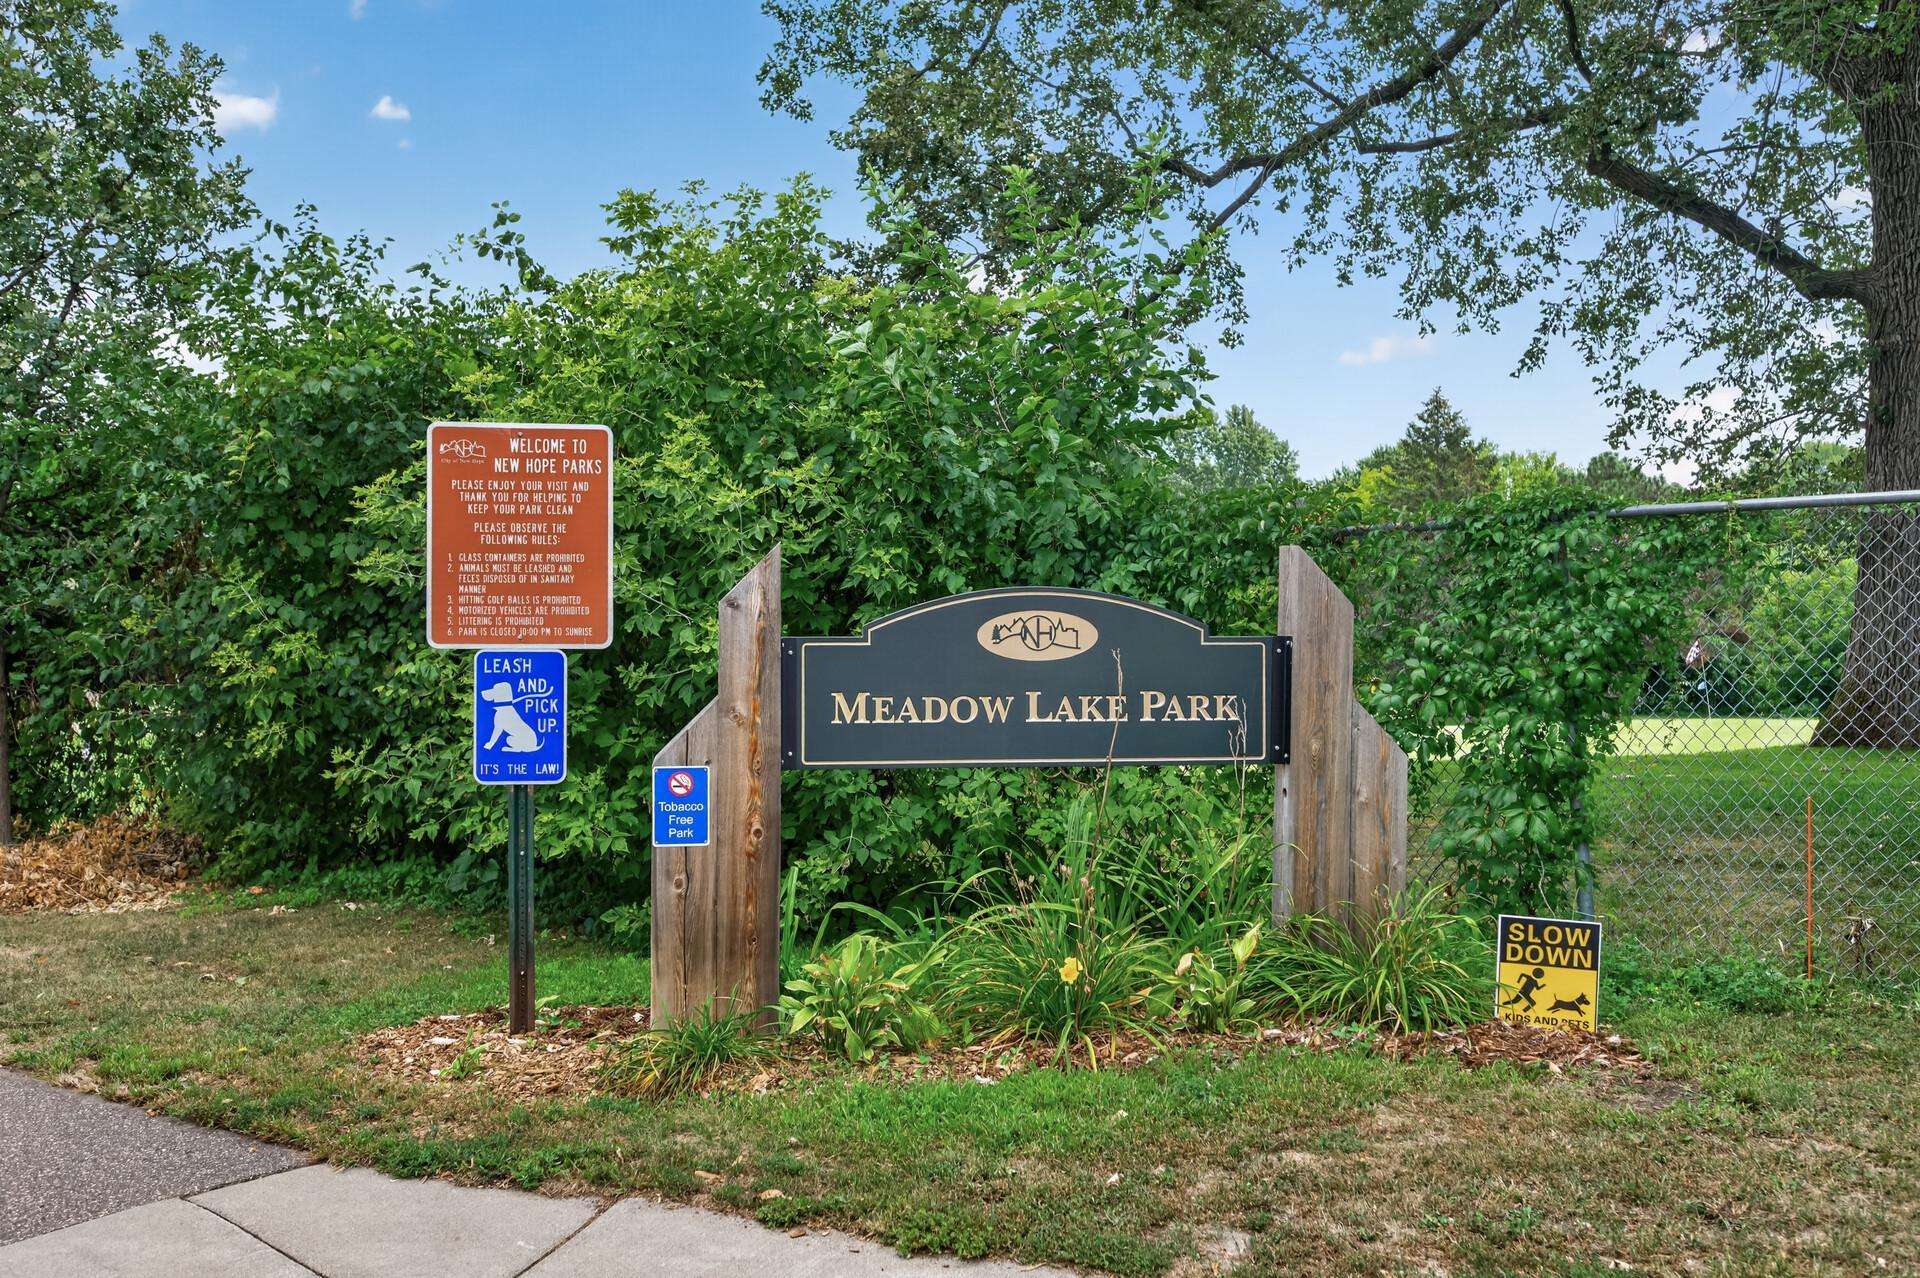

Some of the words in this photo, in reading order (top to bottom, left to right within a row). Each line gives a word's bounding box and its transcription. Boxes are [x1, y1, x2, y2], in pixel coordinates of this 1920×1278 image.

[510, 438, 565, 454] WELCOME
[573, 439, 586, 454] TO
[494, 458, 519, 473] NEW
[526, 459, 556, 473] HOPE
[563, 460, 602, 474] PARKS
[452, 480, 484, 490] PLEASE
[488, 480, 515, 490] ENJOY
[521, 481, 543, 491] YOUR
[547, 481, 568, 491] VISIT
[573, 482, 589, 491] AND
[460, 492, 487, 502] THANK
[492, 492, 508, 502] YOU
[513, 493, 528, 502] FOR
[533, 493, 567, 503] HELPING
[571, 494, 581, 503] TO
[468, 504, 488, 514] KEEP
[494, 505, 515, 514] YOUR
[520, 505, 542, 515] PARK
[547, 505, 573, 515] CLEAN
[474, 523, 506, 533] PLEASE
[511, 523, 547, 533] OBSERVE
[552, 524, 567, 533] THE
[481, 535, 527, 545] FOLLOWING
[532, 535, 561, 545] RULES:
[459, 553, 482, 562] GLASS
[485, 553, 526, 562] CONTAINERS
[530, 554, 543, 562] ARE
[546, 554, 585, 562] PROHIBITED
[448, 563, 453, 572] 2.
[459, 564, 489, 572] ANIMALS
[492, 564, 509, 572] MUST
[513, 564, 522, 573] BE
[525, 564, 555, 573] LEASHED
[559, 564, 572, 573] AND
[459, 575, 480, 583] FECES
[483, 575, 516, 583] DISPOSED
[519, 575, 527, 583] OF
[530, 575, 537, 583] IN
[540, 575, 575, 584] SANITARY
[459, 585, 487, 593] MANNER
[459, 595, 484, 604] HITTING
[487, 596, 504, 604] GOLF
[508, 596, 530, 604] BALLS
[533, 596, 539, 604] IS
[543, 596, 581, 605] PROHIBITED
[448, 606, 453, 615] 4.
[459, 606, 496, 615] MOTORIZED
[500, 606, 532, 615] VEHICLES
[535, 607, 548, 615] ARE
[551, 607, 590, 615] PROHIBITED
[448, 617, 453, 625] 5.
[459, 617, 492, 625] LITTERING
[496, 617, 502, 625] IS
[505, 617, 544, 626] PROHIBITED
[448, 627, 453, 636] 6.
[459, 627, 477, 636] PARK
[480, 628, 487, 636] IS
[491, 628, 516, 636] CLOSED
[541, 628, 551, 636] PM
[554, 628, 562, 636] TO
[565, 628, 593, 637] SUNRISE
[484, 658, 531, 673] LEASH
[518, 679, 547, 693] AND
[525, 699, 558, 713] PICK
[537, 719, 559, 733] UP.
[480, 764, 499, 775] IT'S
[508, 764, 527, 774] THE
[536, 763, 559, 774] LAW!
[658, 802, 703, 811] Tobacco
[669, 815, 693, 824] Free
[669, 828, 693, 838] Park
[1508, 923, 1591, 947] SLOW
[1506, 943, 1592, 968] DOWN
[1505, 1013, 1530, 1023] KIDS
[1534, 1016, 1558, 1026] AND
